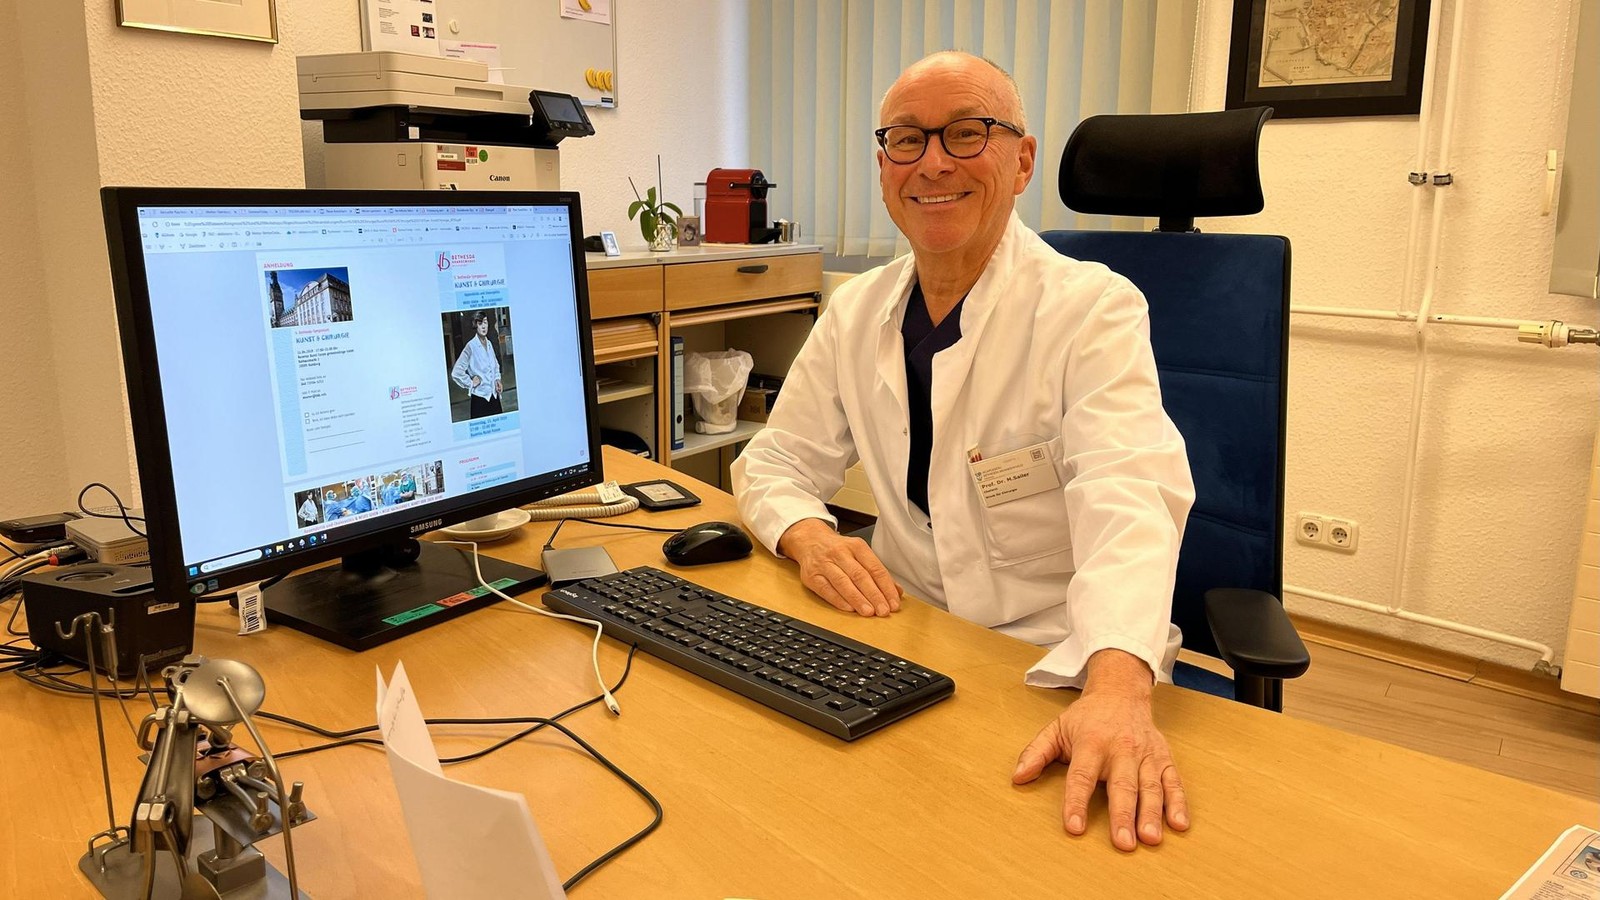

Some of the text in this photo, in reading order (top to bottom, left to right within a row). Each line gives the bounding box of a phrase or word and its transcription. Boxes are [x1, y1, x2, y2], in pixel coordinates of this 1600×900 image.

[489, 174, 511, 182] Canon
[296, 336, 316, 344] KUNST
[321, 332, 350, 341] CHIRURGIE
[410, 518, 443, 534] SAMSUNG
